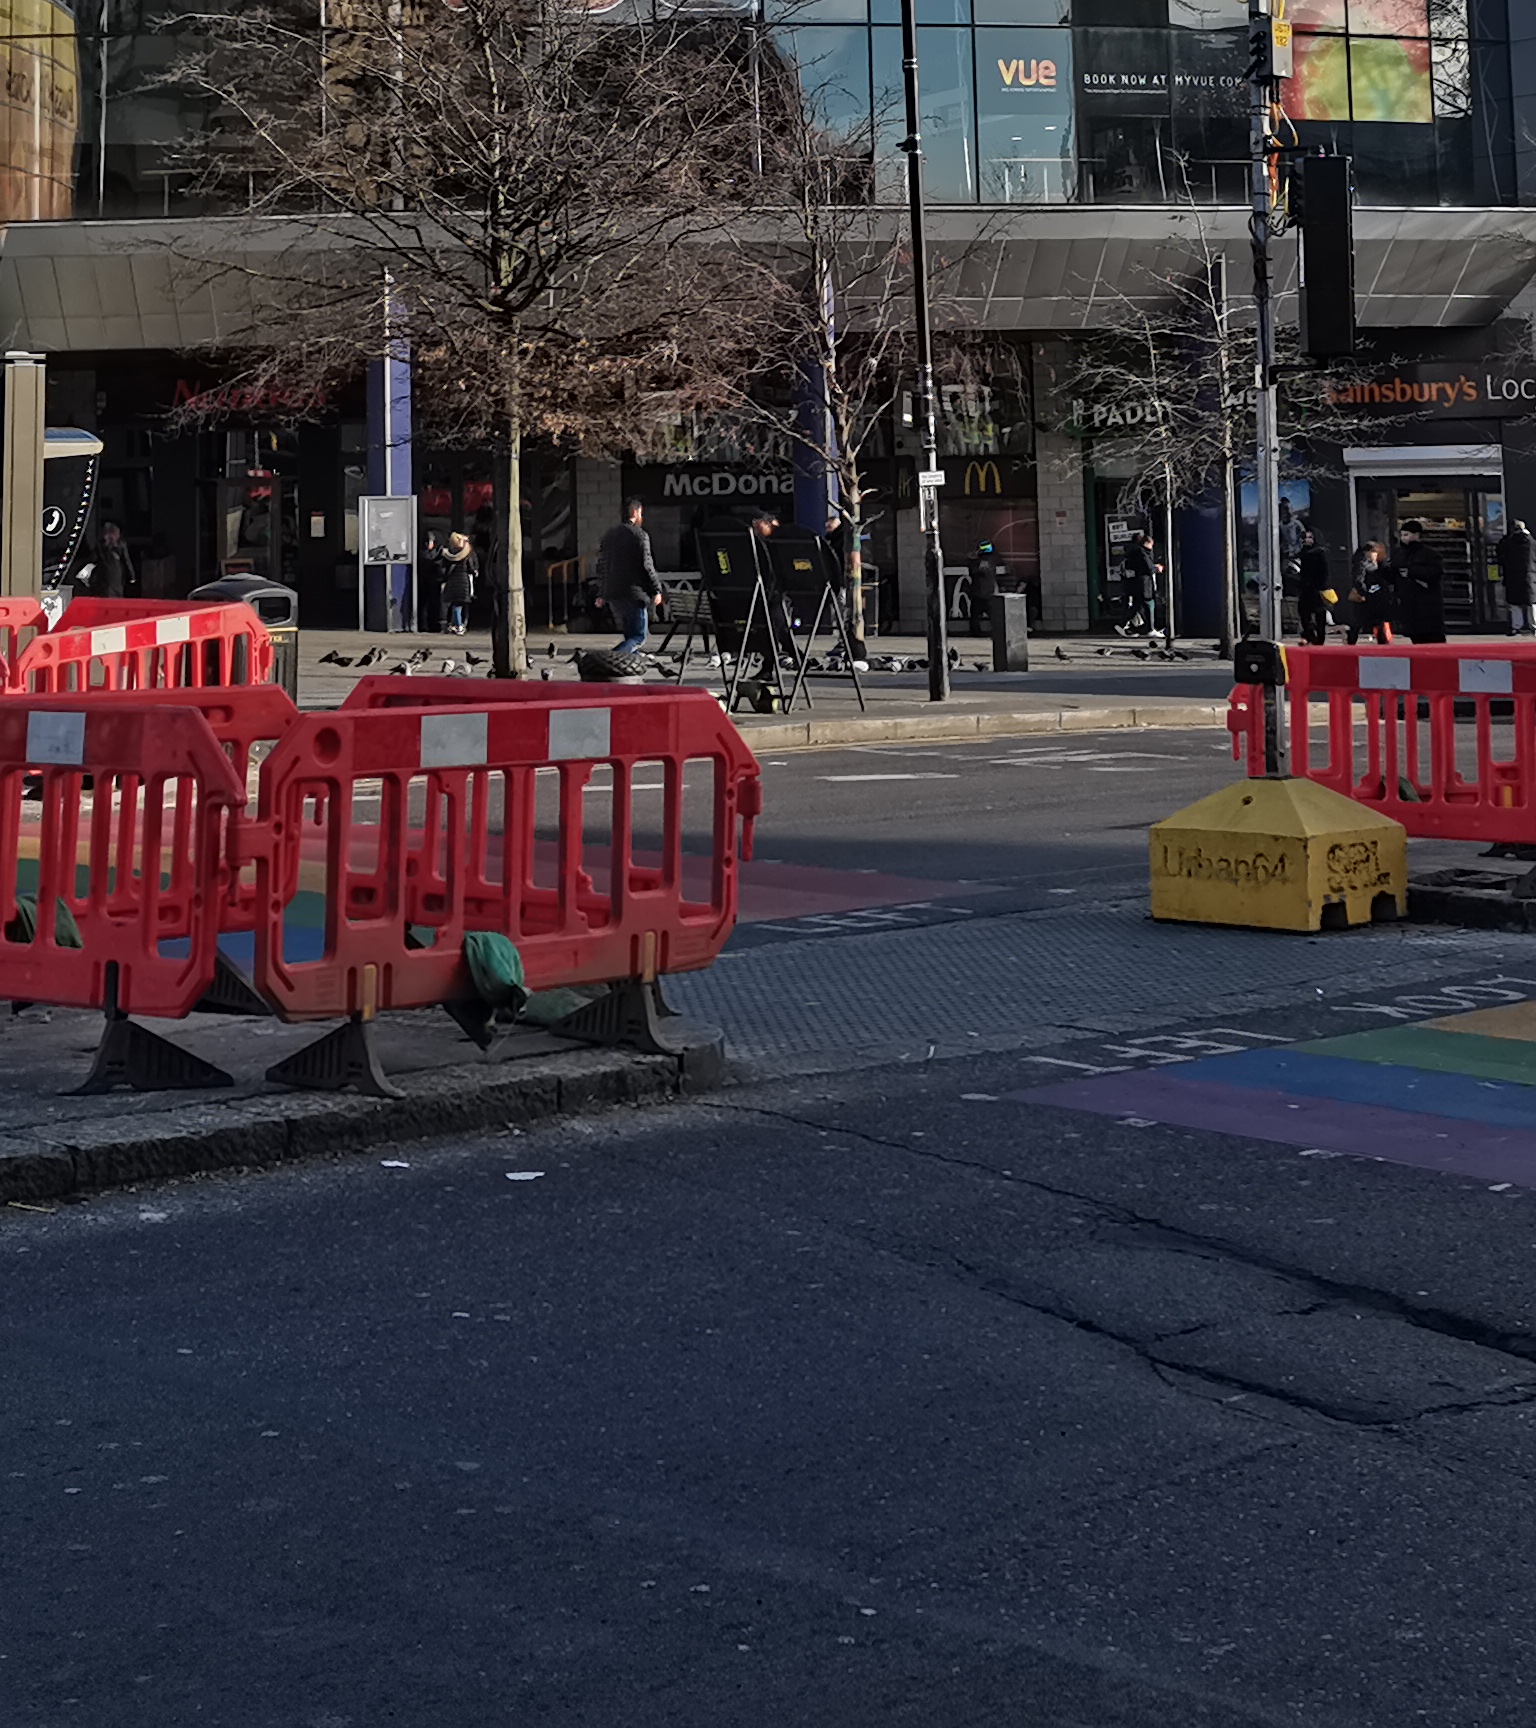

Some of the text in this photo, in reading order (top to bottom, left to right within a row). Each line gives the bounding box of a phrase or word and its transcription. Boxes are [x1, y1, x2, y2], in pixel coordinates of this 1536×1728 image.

[1084, 73, 1116, 85] BOOK
[1121, 74, 1147, 85] NOW
[1152, 74, 1166, 85] AT
[664, 472, 794, 497] McDona
